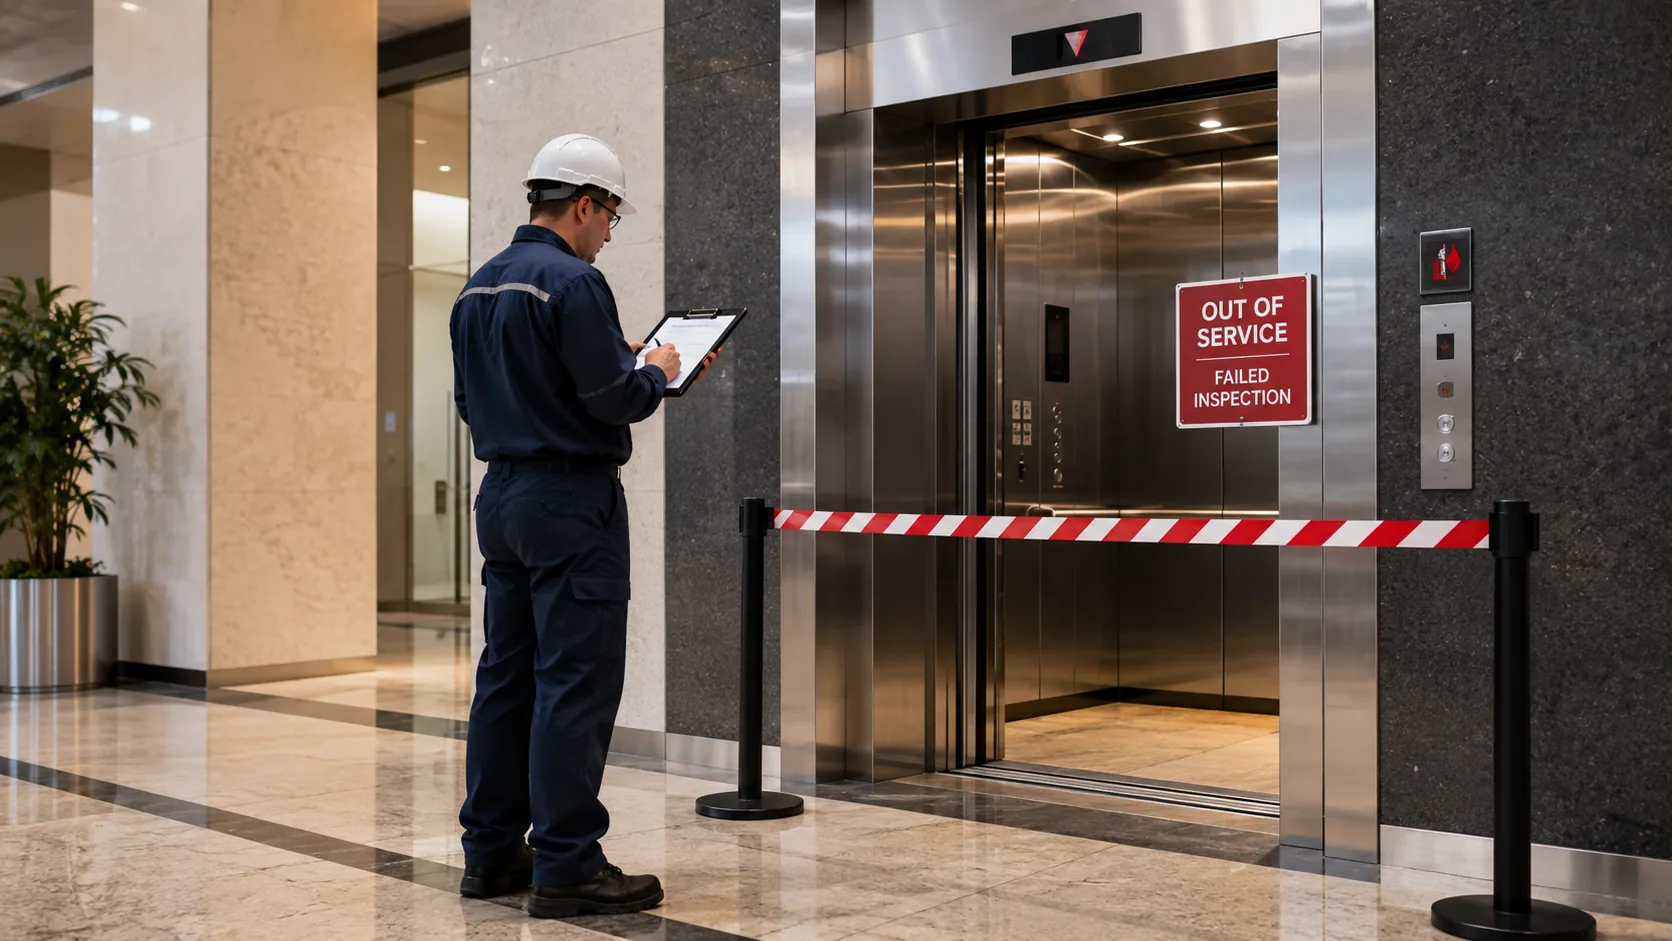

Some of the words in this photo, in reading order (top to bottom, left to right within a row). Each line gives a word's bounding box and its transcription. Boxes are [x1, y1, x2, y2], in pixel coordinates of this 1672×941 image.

[1201, 299, 1247, 321] OUT
[1253, 295, 1284, 317] OF
[1197, 322, 1288, 348] SERVICE
[1214, 368, 1270, 385] FAILED
[1194, 388, 1292, 408] INSPECTION
